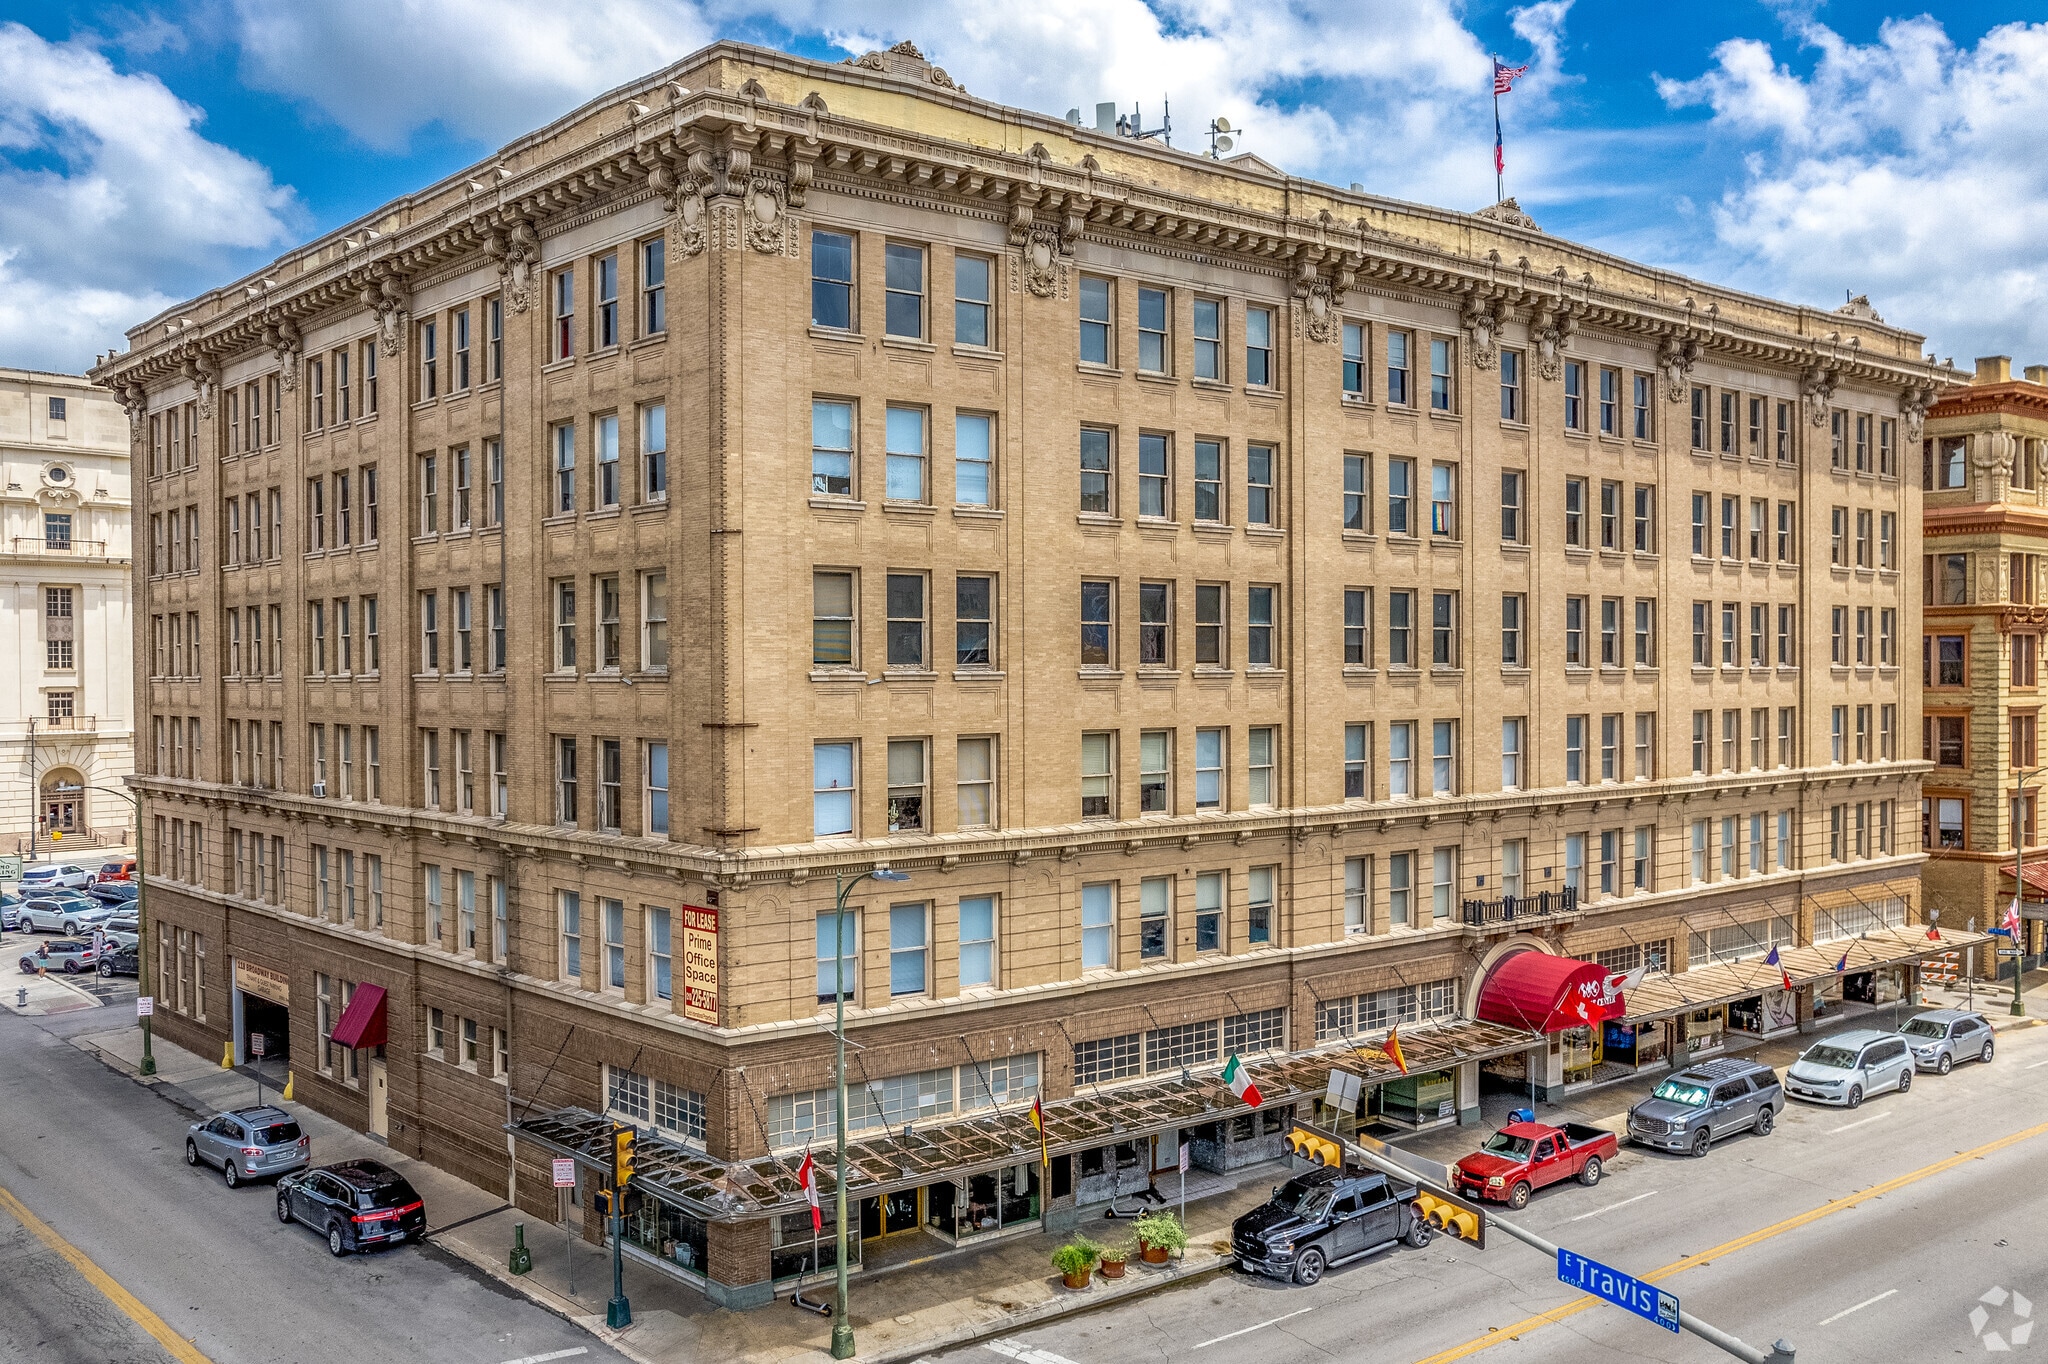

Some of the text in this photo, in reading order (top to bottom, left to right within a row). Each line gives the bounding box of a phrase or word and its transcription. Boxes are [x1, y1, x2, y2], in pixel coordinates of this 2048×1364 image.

[684, 910, 716, 931] FOR LEASE
[688, 932, 712, 951] Prime
[686, 951, 716, 969] Office
[246, 963, 270, 979] BROADWAY
[270, 972, 289, 985] BUILDIN
[686, 966, 716, 984] Space
[1596, 994, 1616, 1007] CENTER
[1565, 1253, 1652, 1313] E Travis
